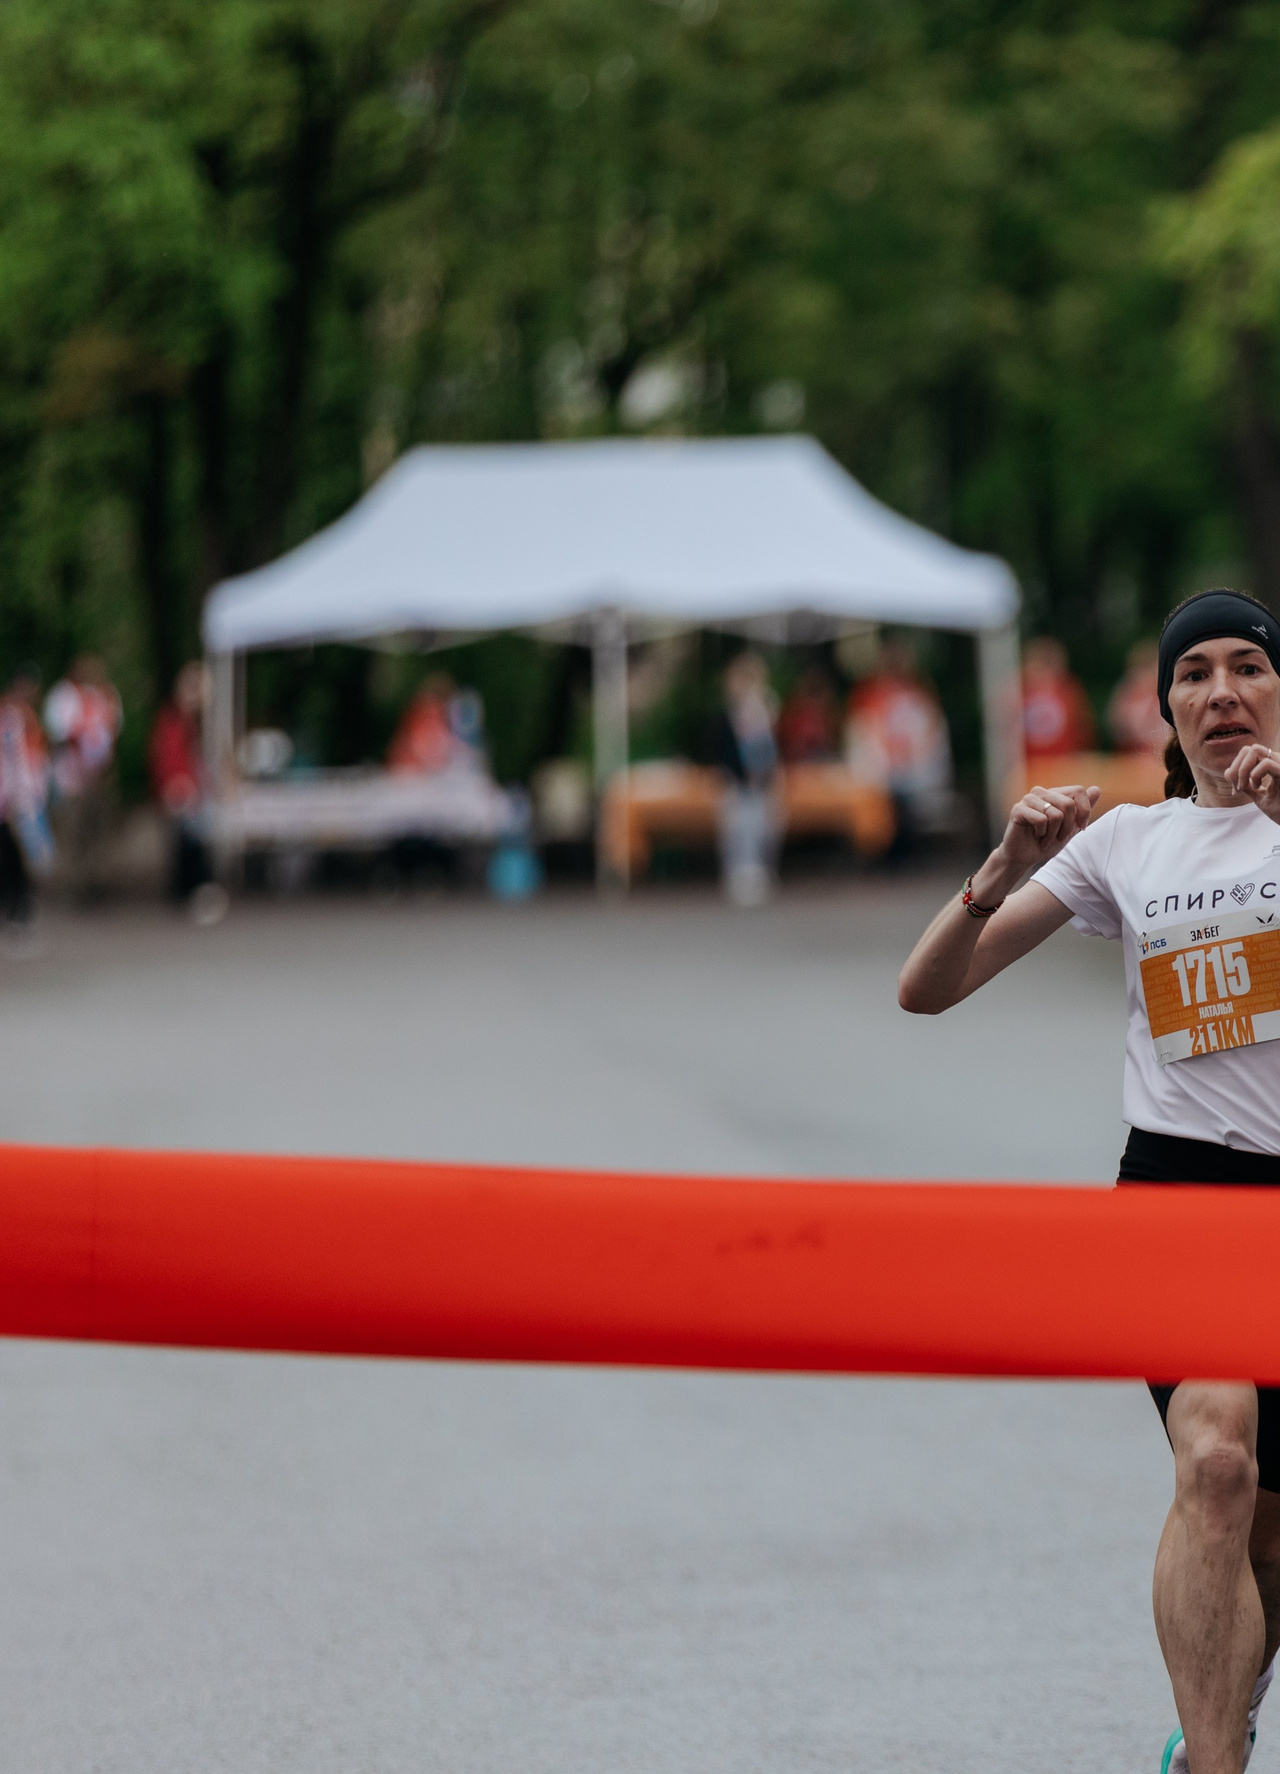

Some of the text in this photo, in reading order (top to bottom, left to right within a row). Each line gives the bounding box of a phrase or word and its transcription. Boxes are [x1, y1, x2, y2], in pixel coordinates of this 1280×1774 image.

[1150, 938, 1167, 950] ПСБ
[1172, 941, 1252, 1007] 1715
[1198, 1001, 1234, 1020] НАТАЛЬЯ
